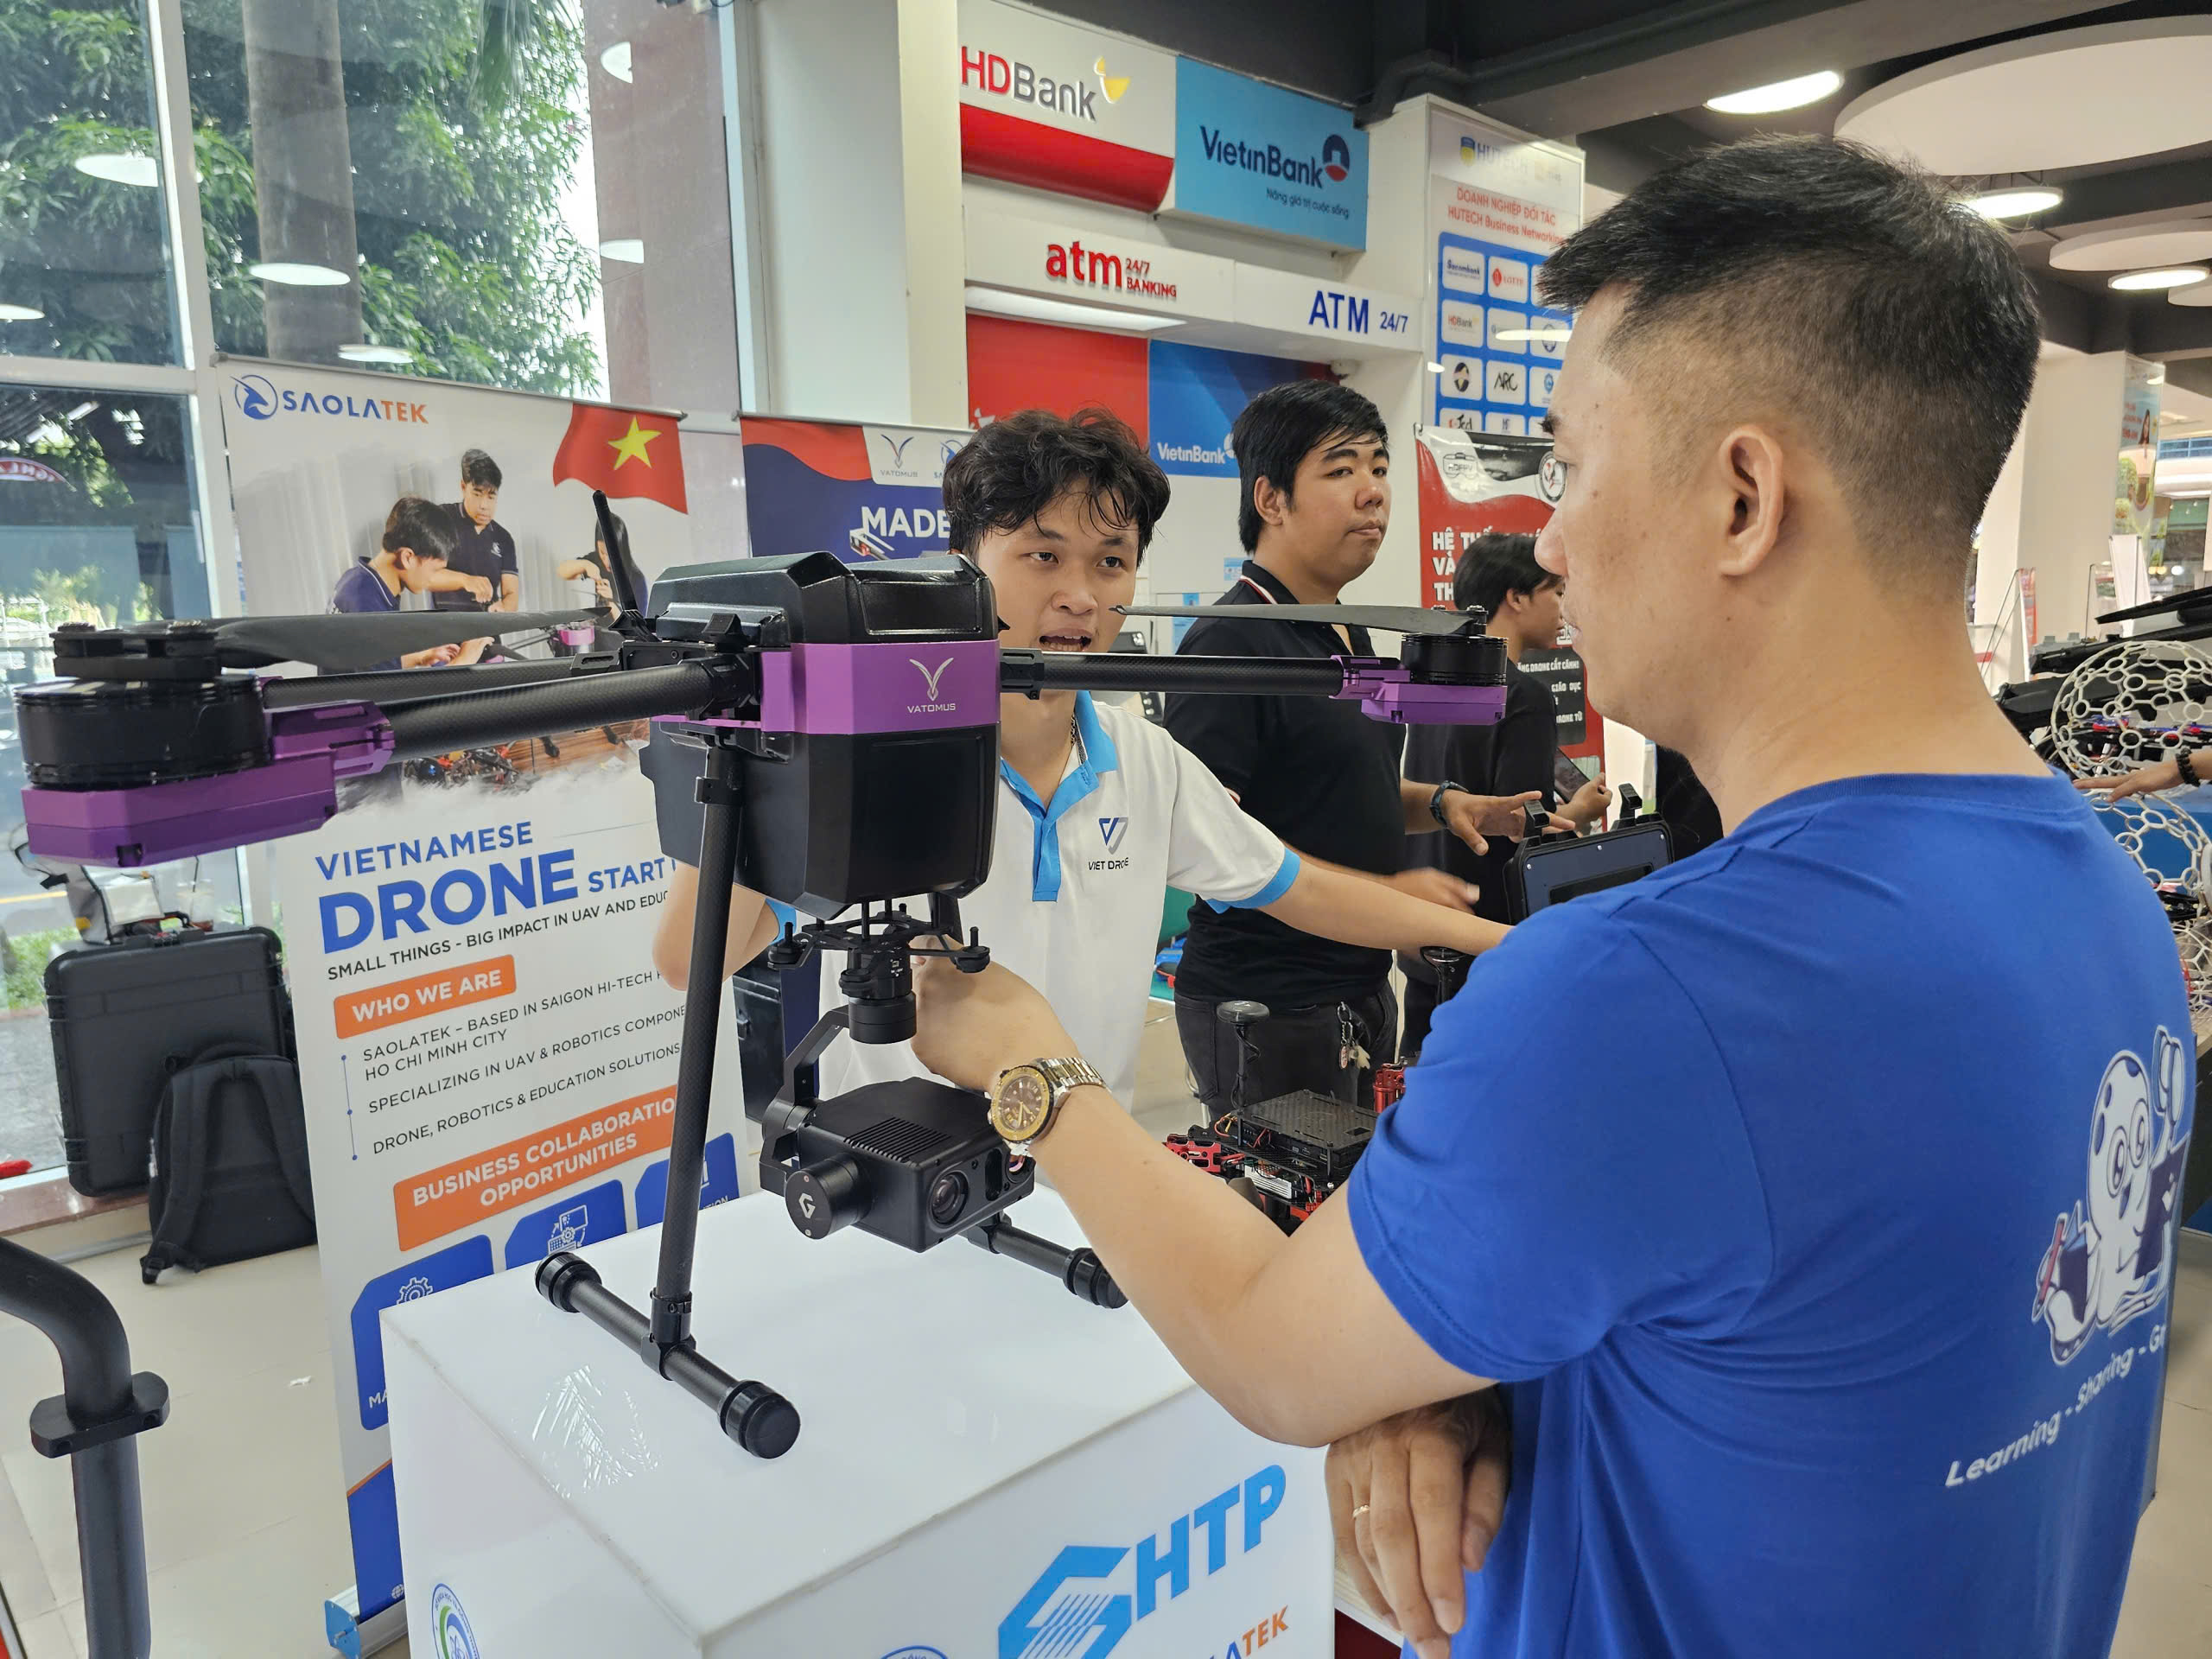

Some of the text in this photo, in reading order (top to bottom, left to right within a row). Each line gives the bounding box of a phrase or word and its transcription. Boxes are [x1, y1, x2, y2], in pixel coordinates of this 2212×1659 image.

[960, 46, 1096, 121] HDBank
[1199, 124, 1324, 189] VietinBank
[1447, 206, 1484, 226] HUTECH
[1485, 215, 1519, 236] Business
[1457, 187, 1489, 207] DOANH
[1541, 207, 1556, 226] TÁC
[1045, 239, 1150, 289] atm 24/7
[1126, 276, 1178, 299] BANKING
[1446, 259, 1480, 276] Sacombank
[1307, 289, 1409, 334] ATM 24/7
[1448, 313, 1473, 329] HDBank
[282, 388, 429, 425] SAOLATEK
[1493, 372, 1518, 391] ARC
[880, 469, 918, 478] VATOMUS
[1157, 442, 1226, 465] VietinBank
[861, 505, 951, 539] MADE
[907, 703, 957, 714] VATOMUS
[315, 820, 534, 881] VIETNAMESE
[1088, 861, 1106, 871] VIET
[318, 848, 665, 955] DRONE START
[327, 952, 386, 981] SMALL
[390, 939, 452, 968] THINGS
[467, 931, 494, 948] BIG
[498, 917, 550, 942] IMPACT
[553, 913, 569, 928] IN
[571, 906, 601, 924] UAV
[604, 899, 637, 916] AND
[351, 969, 503, 1024] WHO WE ARE
[362, 1026, 451, 1063] SAOLATEK
[467, 1007, 519, 1033] BASED
[523, 1001, 537, 1018] IN
[541, 985, 594, 1012] SAIGON
[597, 971, 654, 995] HI-TECH
[365, 1028, 509, 1082] HO CHI MINH CITY
[368, 1004, 686, 1115] SPECIALIZING IN UAV & ROBOTICS COMPONE
[372, 1042, 681, 1155] DRONE, ROBOTICS & EDUCATION SOLUTIONS
[412, 1097, 676, 1207] BUSINESS COLLABORATIO
[479, 1132, 639, 1208] OPPORTUNITIES
[1944, 1412, 2061, 1489] Learning
[2075, 1350, 2134, 1414] Sharing
